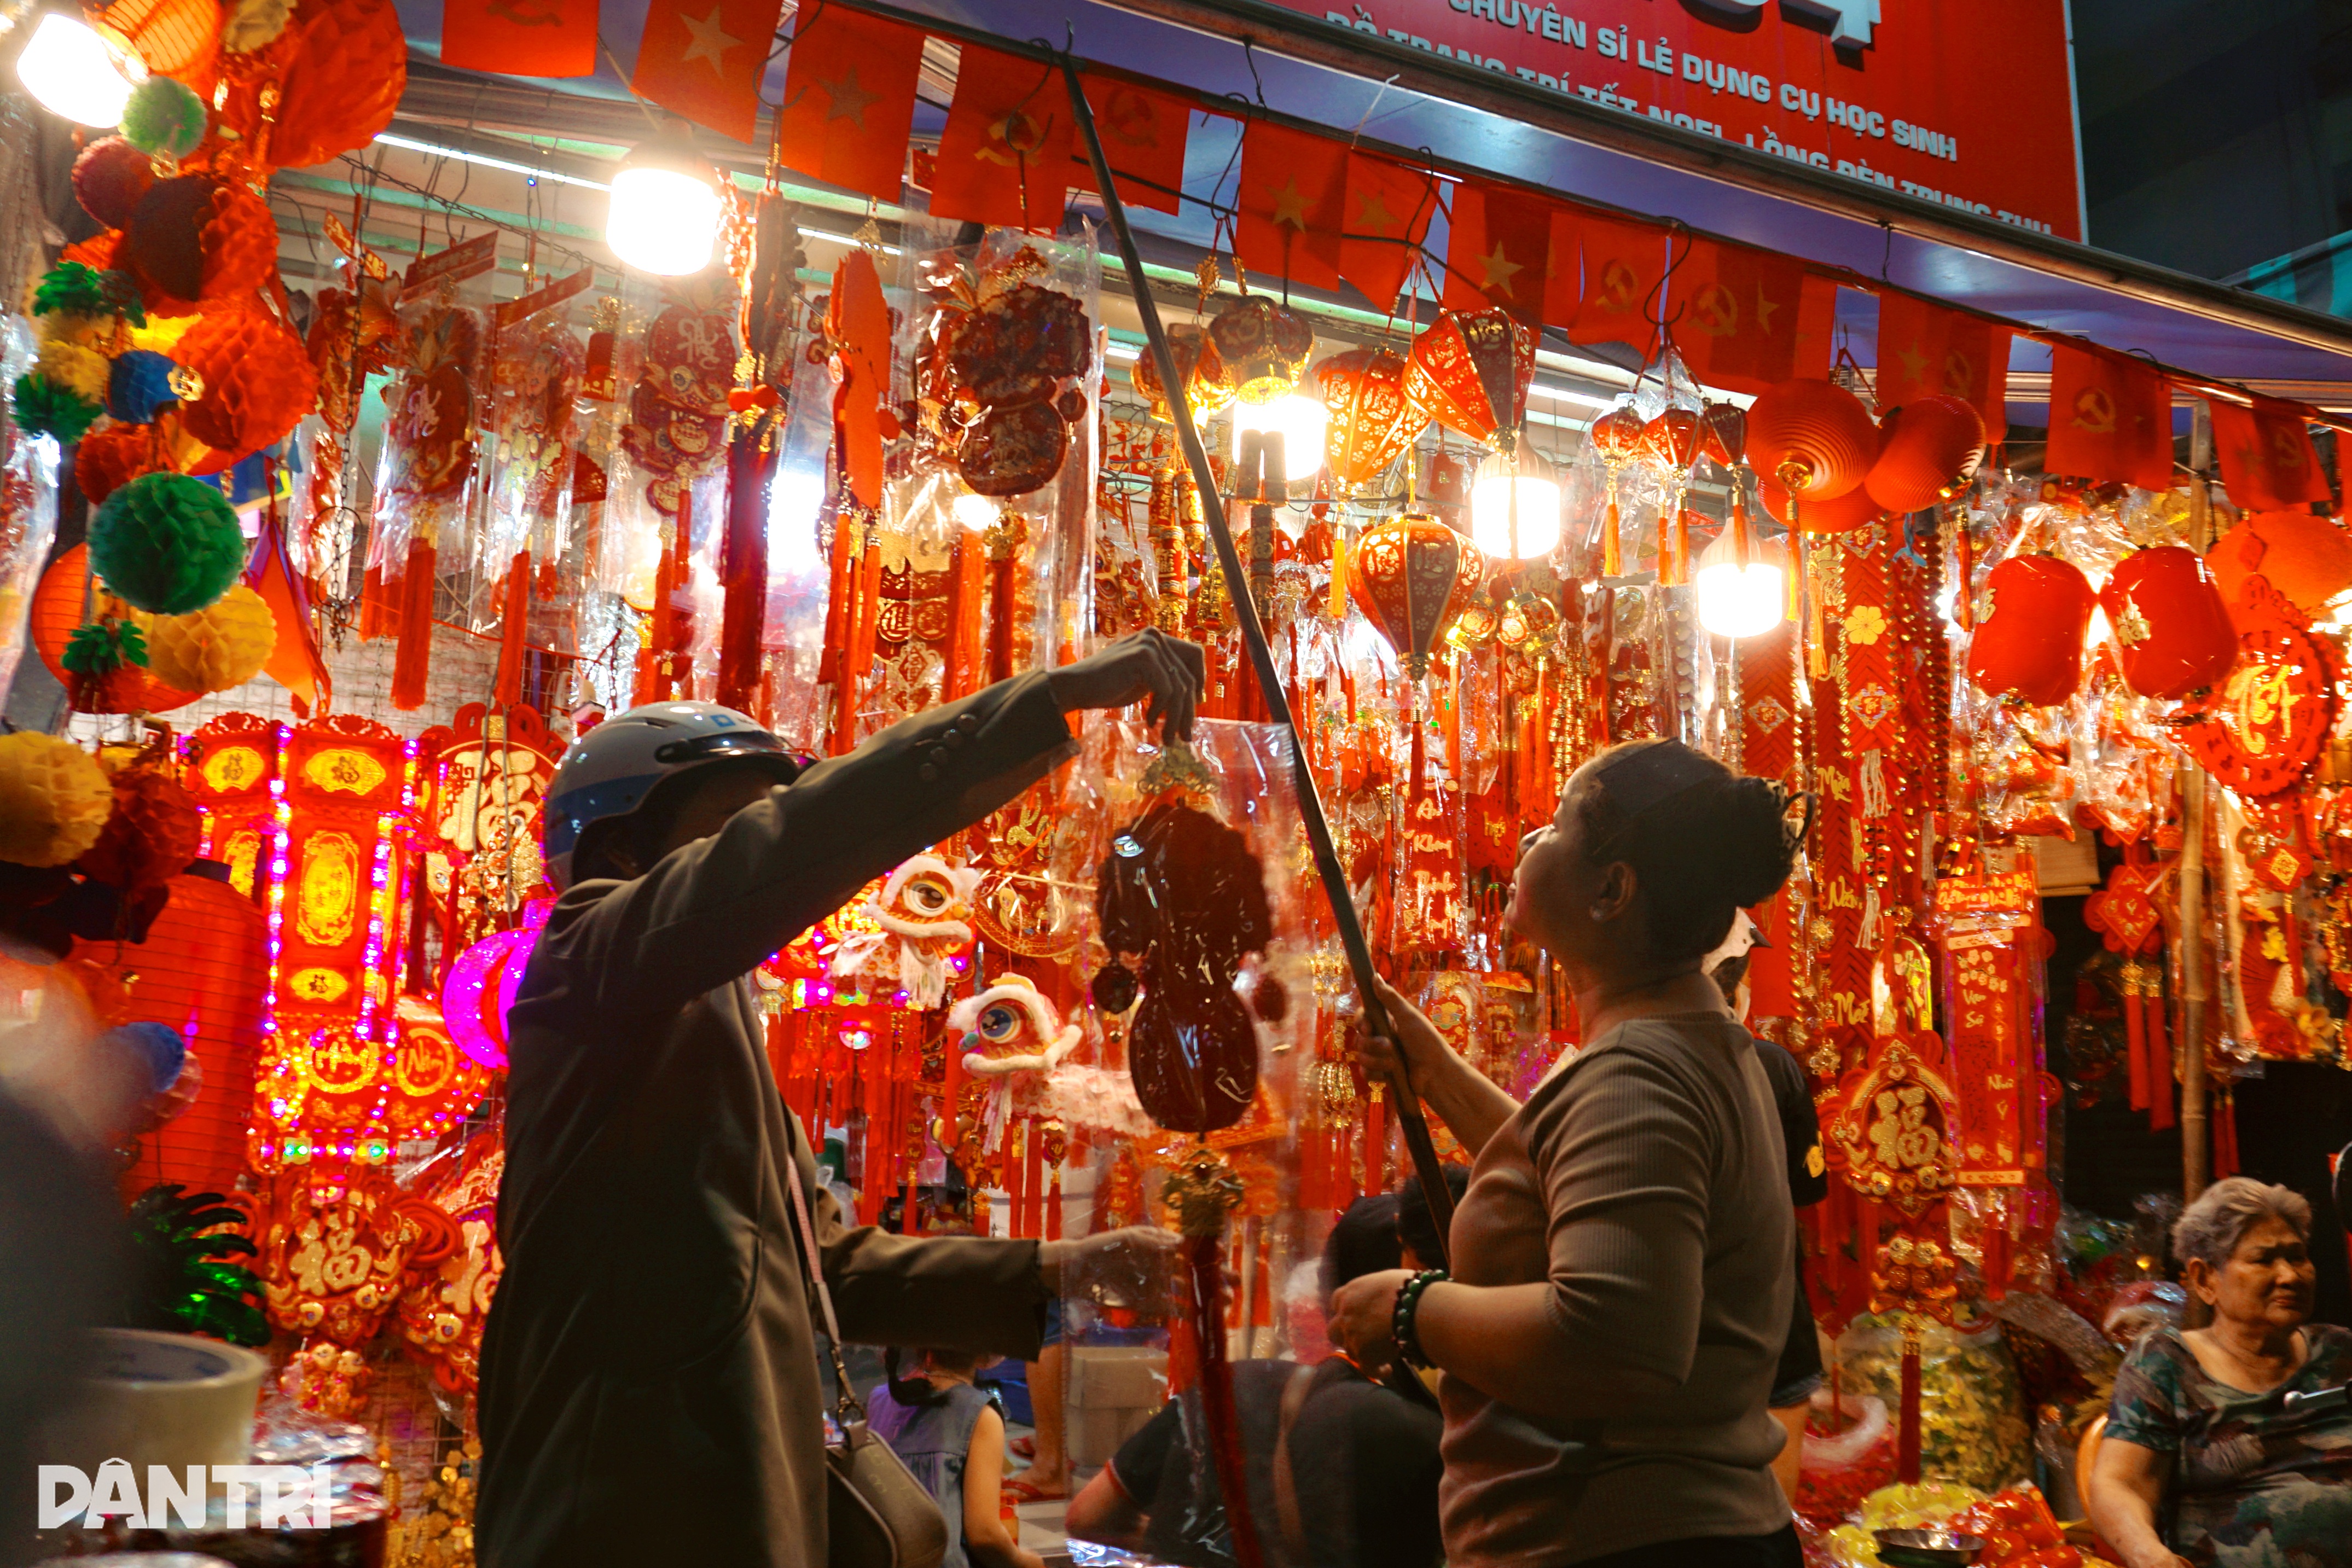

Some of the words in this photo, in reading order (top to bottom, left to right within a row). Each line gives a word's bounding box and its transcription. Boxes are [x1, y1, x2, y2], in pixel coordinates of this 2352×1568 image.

[1597, 24, 1628, 61] SỈ
[1637, 37, 1674, 75] LẺ
[1682, 53, 1771, 103] DỤNG
[1780, 84, 1820, 121] CỤ
[1826, 97, 1885, 138] HỌC
[1892, 118, 1958, 162] SINH
[1869, 1086, 1939, 1170] 福
